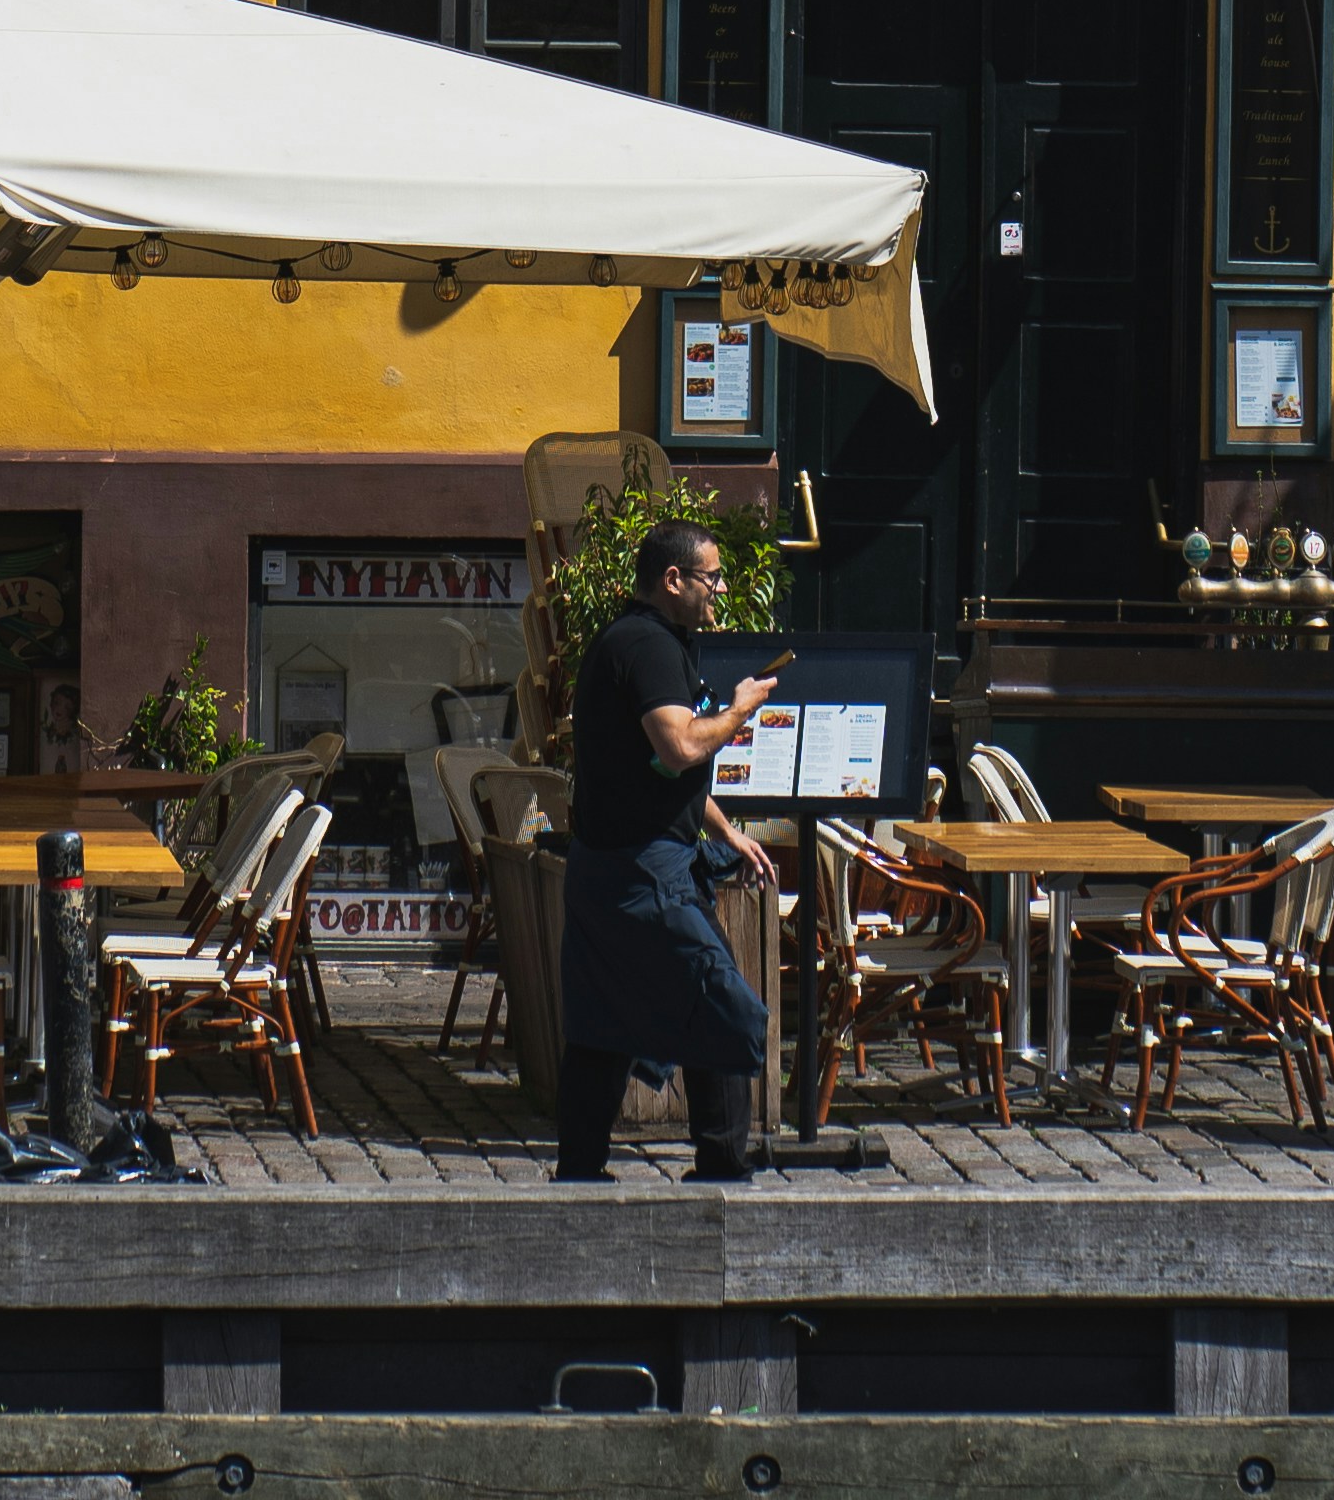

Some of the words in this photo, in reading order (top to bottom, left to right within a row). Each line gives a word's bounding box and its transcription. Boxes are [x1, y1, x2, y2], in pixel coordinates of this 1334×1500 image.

[1265, 11, 1284, 23] Old
[1260, 57, 1291, 68] house
[1242, 110, 1305, 122] Traditional
[1255, 133, 1292, 145] Danish
[1258, 156, 1291, 167] Lunch
[296, 559, 512, 599] NYHAVN
